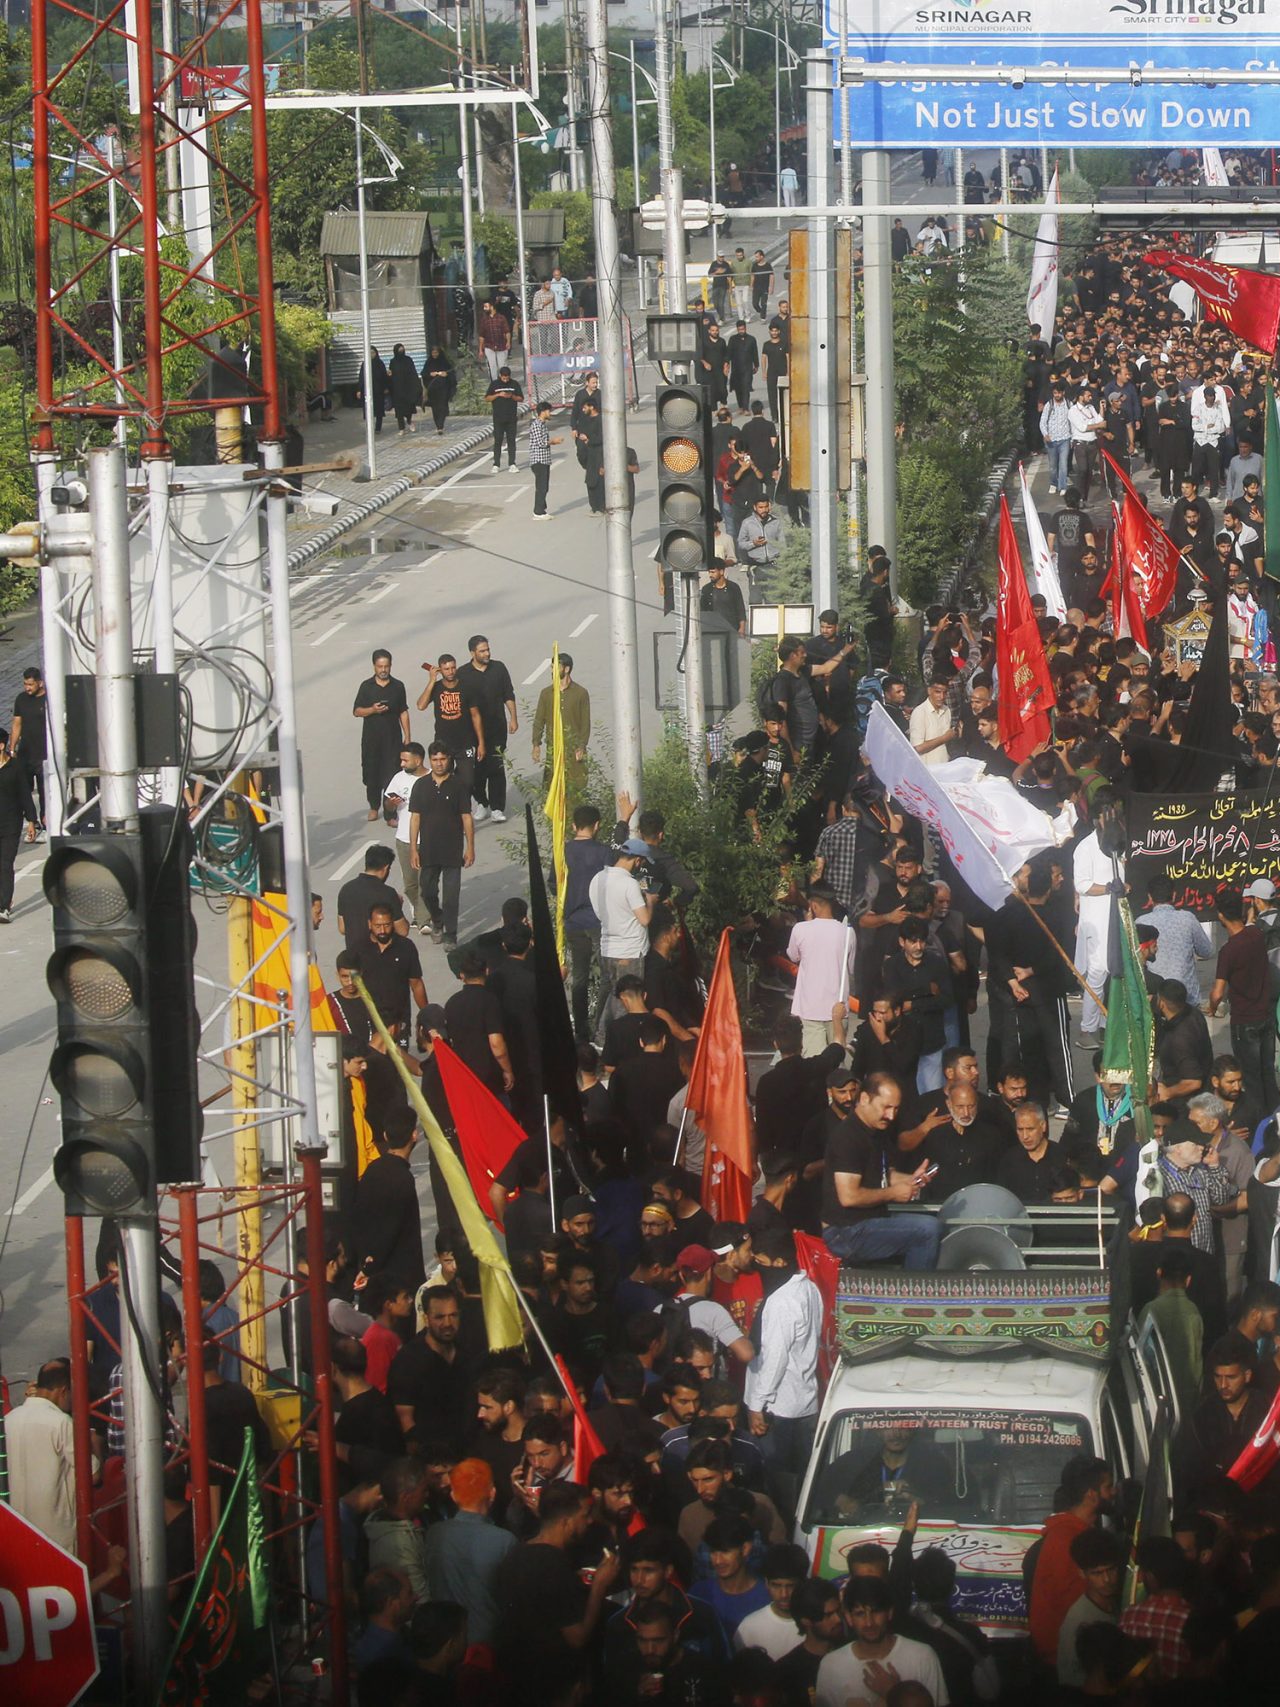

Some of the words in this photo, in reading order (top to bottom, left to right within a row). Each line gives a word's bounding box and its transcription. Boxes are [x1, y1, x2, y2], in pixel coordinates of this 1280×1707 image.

[915, 10, 1032, 24] SRINAGAR
[1123, 16, 1162, 24] SMART
[1164, 16, 1187, 24] CITY
[916, 102, 976, 128] Not
[987, 101, 1054, 128] Just
[1067, 101, 1146, 128] Slow
[1161, 101, 1251, 128] Down
[566, 356, 595, 367] JKP
[863, 1421, 924, 1429] MASUMEEN
[927, 1420, 969, 1429] YATEEM
[972, 1420, 1009, 1429] TRUST
[1000, 1433, 1016, 1444] PH.
